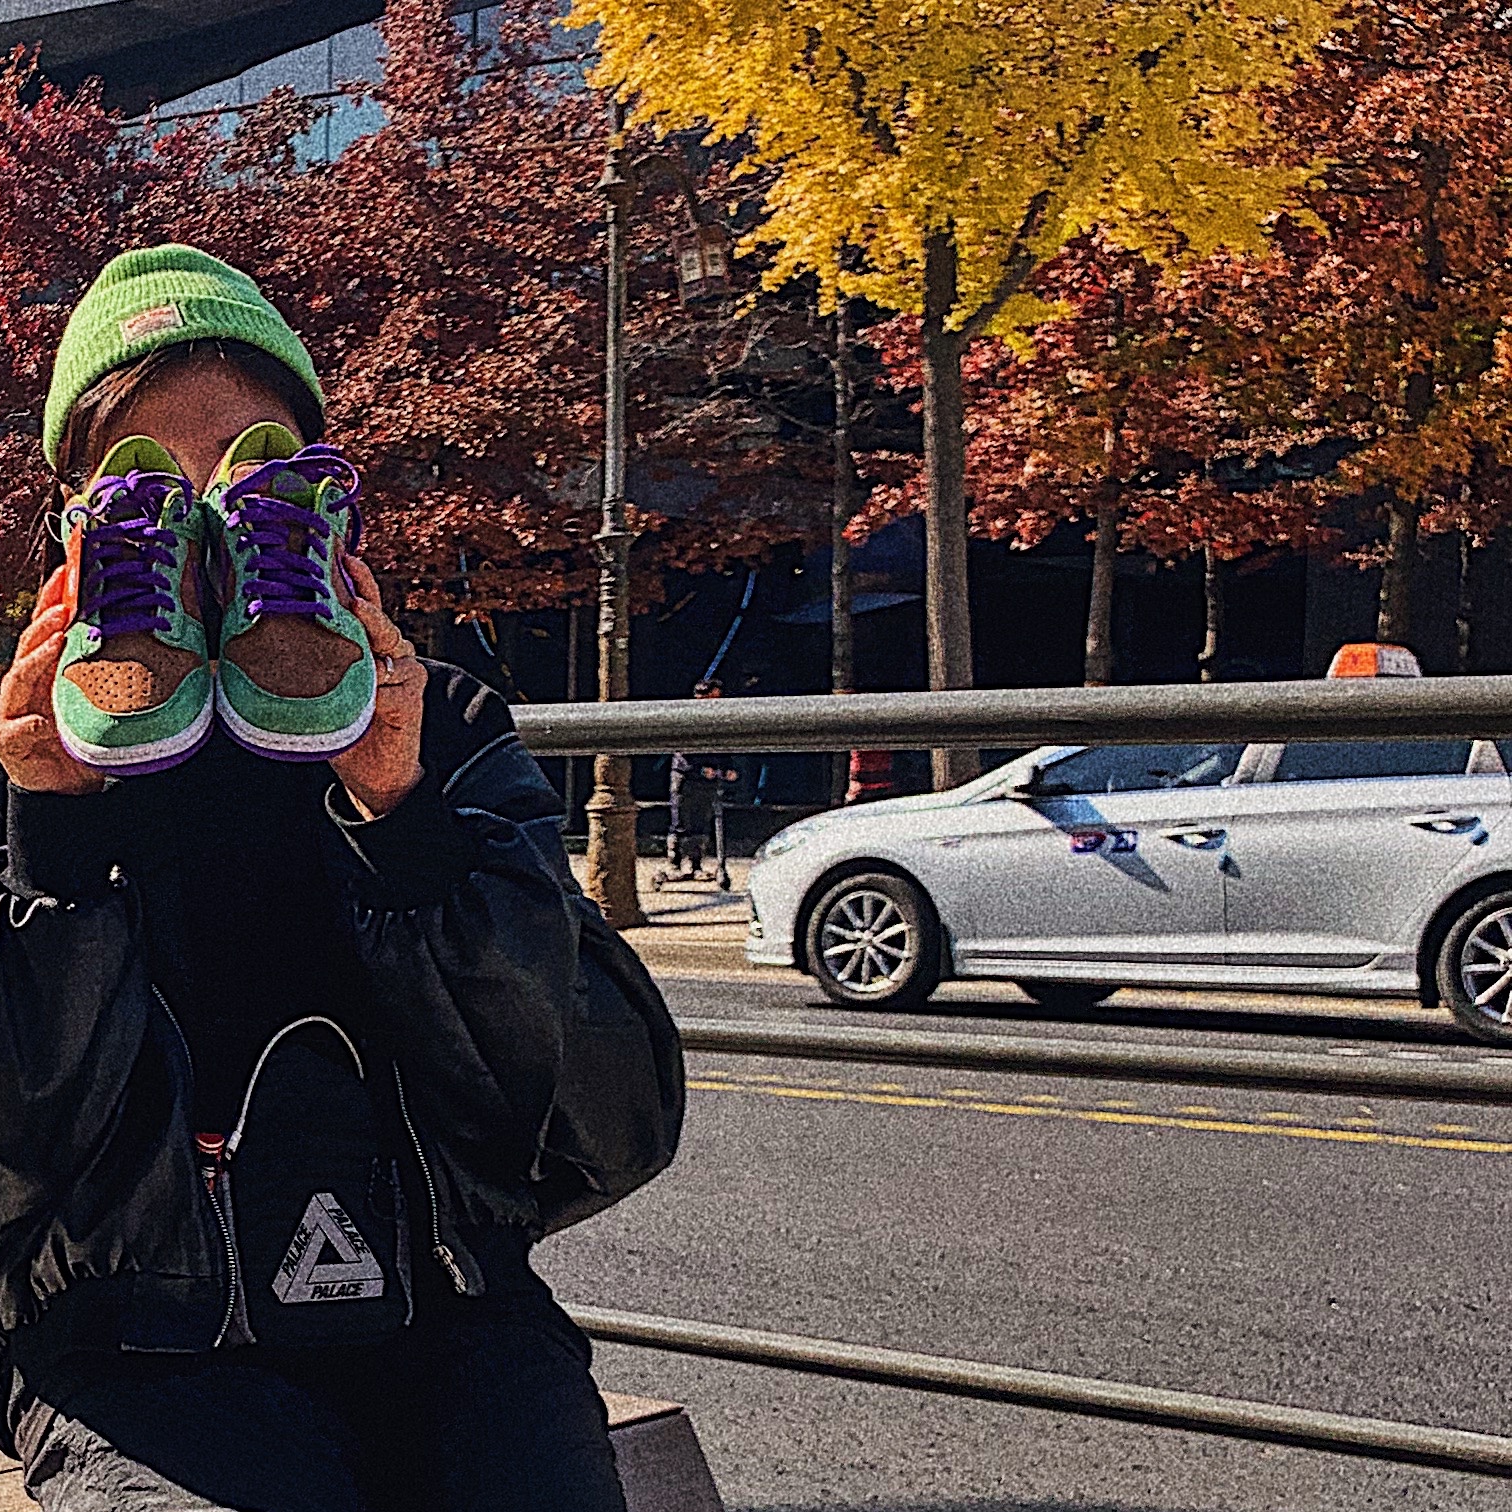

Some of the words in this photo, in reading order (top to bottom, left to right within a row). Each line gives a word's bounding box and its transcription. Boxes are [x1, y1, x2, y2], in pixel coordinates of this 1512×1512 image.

[282, 1222, 312, 1279] PALACE
[327, 1208, 371, 1255] PALACE
[310, 1283, 365, 1299] PALACE
